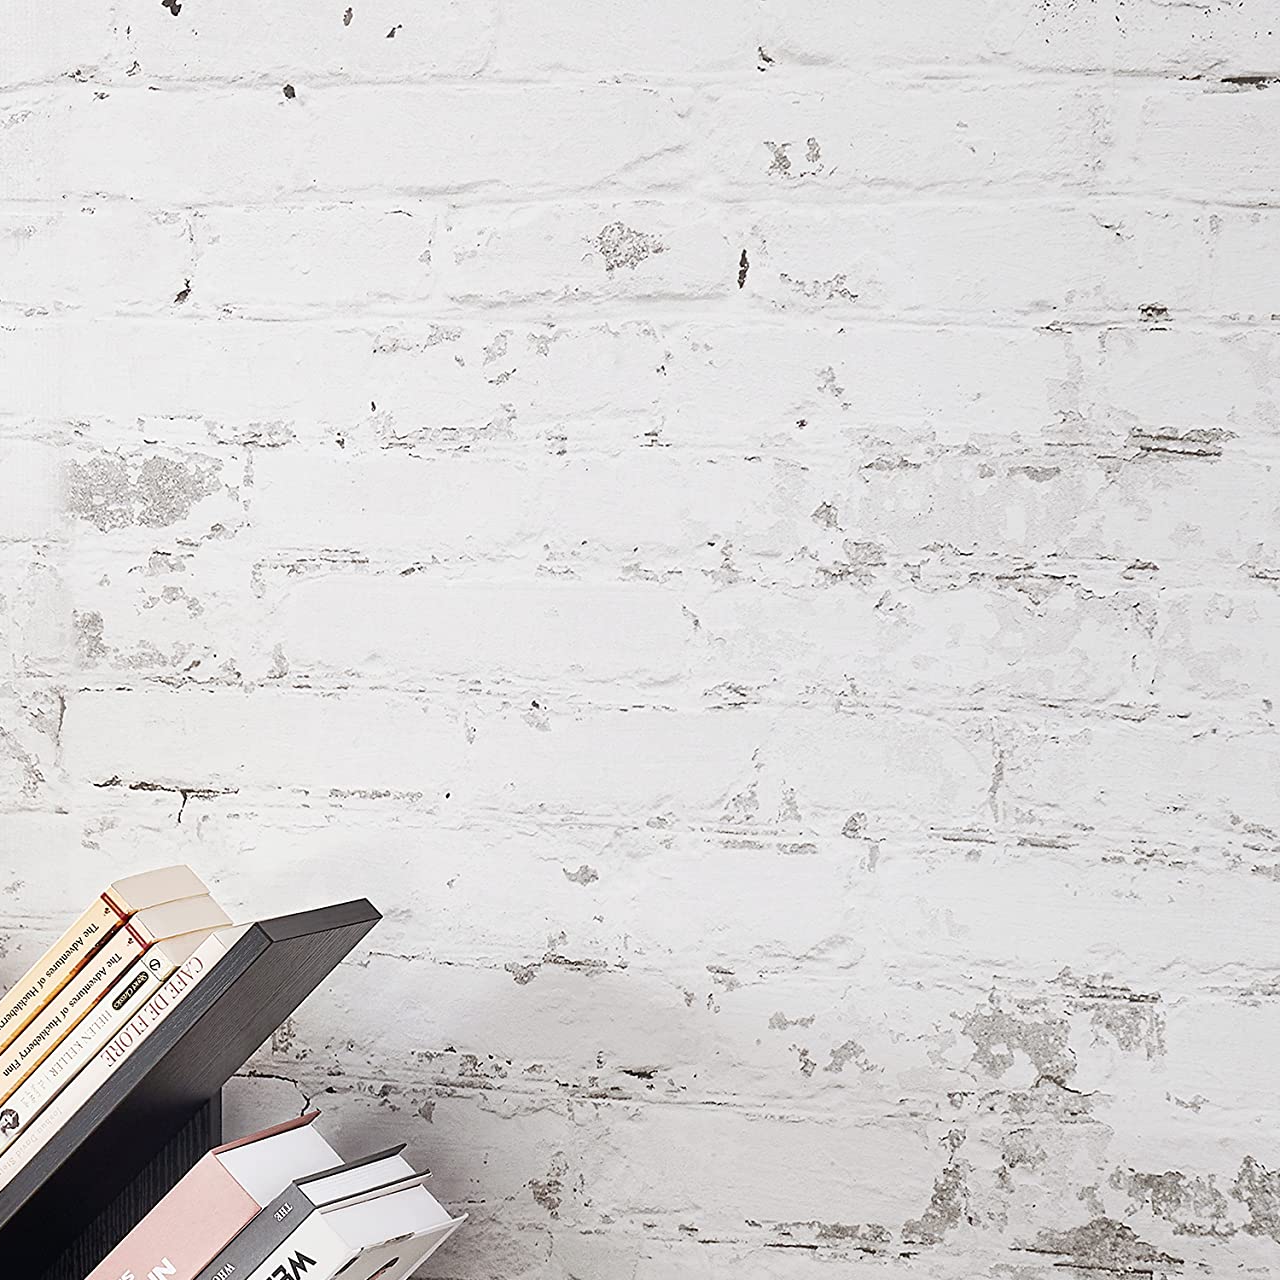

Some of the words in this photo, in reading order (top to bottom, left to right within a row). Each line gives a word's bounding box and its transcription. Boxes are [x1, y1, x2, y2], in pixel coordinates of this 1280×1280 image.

[81, 922, 100, 939] The
[44, 936, 85, 979] Adventures
[105, 952, 123, 969] The
[35, 976, 48, 990] of
[67, 965, 108, 1009] Adventures
[163, 955, 205, 999] CAFE
[58, 1005, 70, 1019] of
[142, 993, 170, 1021] DE
[17, 1014, 62, 1062] Huckleberry
[79, 1008, 113, 1044] HELEN
[99, 1014, 150, 1068] FLORE
[2, 1058, 22, 1078] Finn
[47, 1040, 84, 1078] KELLER
[272, 1201, 294, 1223] THE
